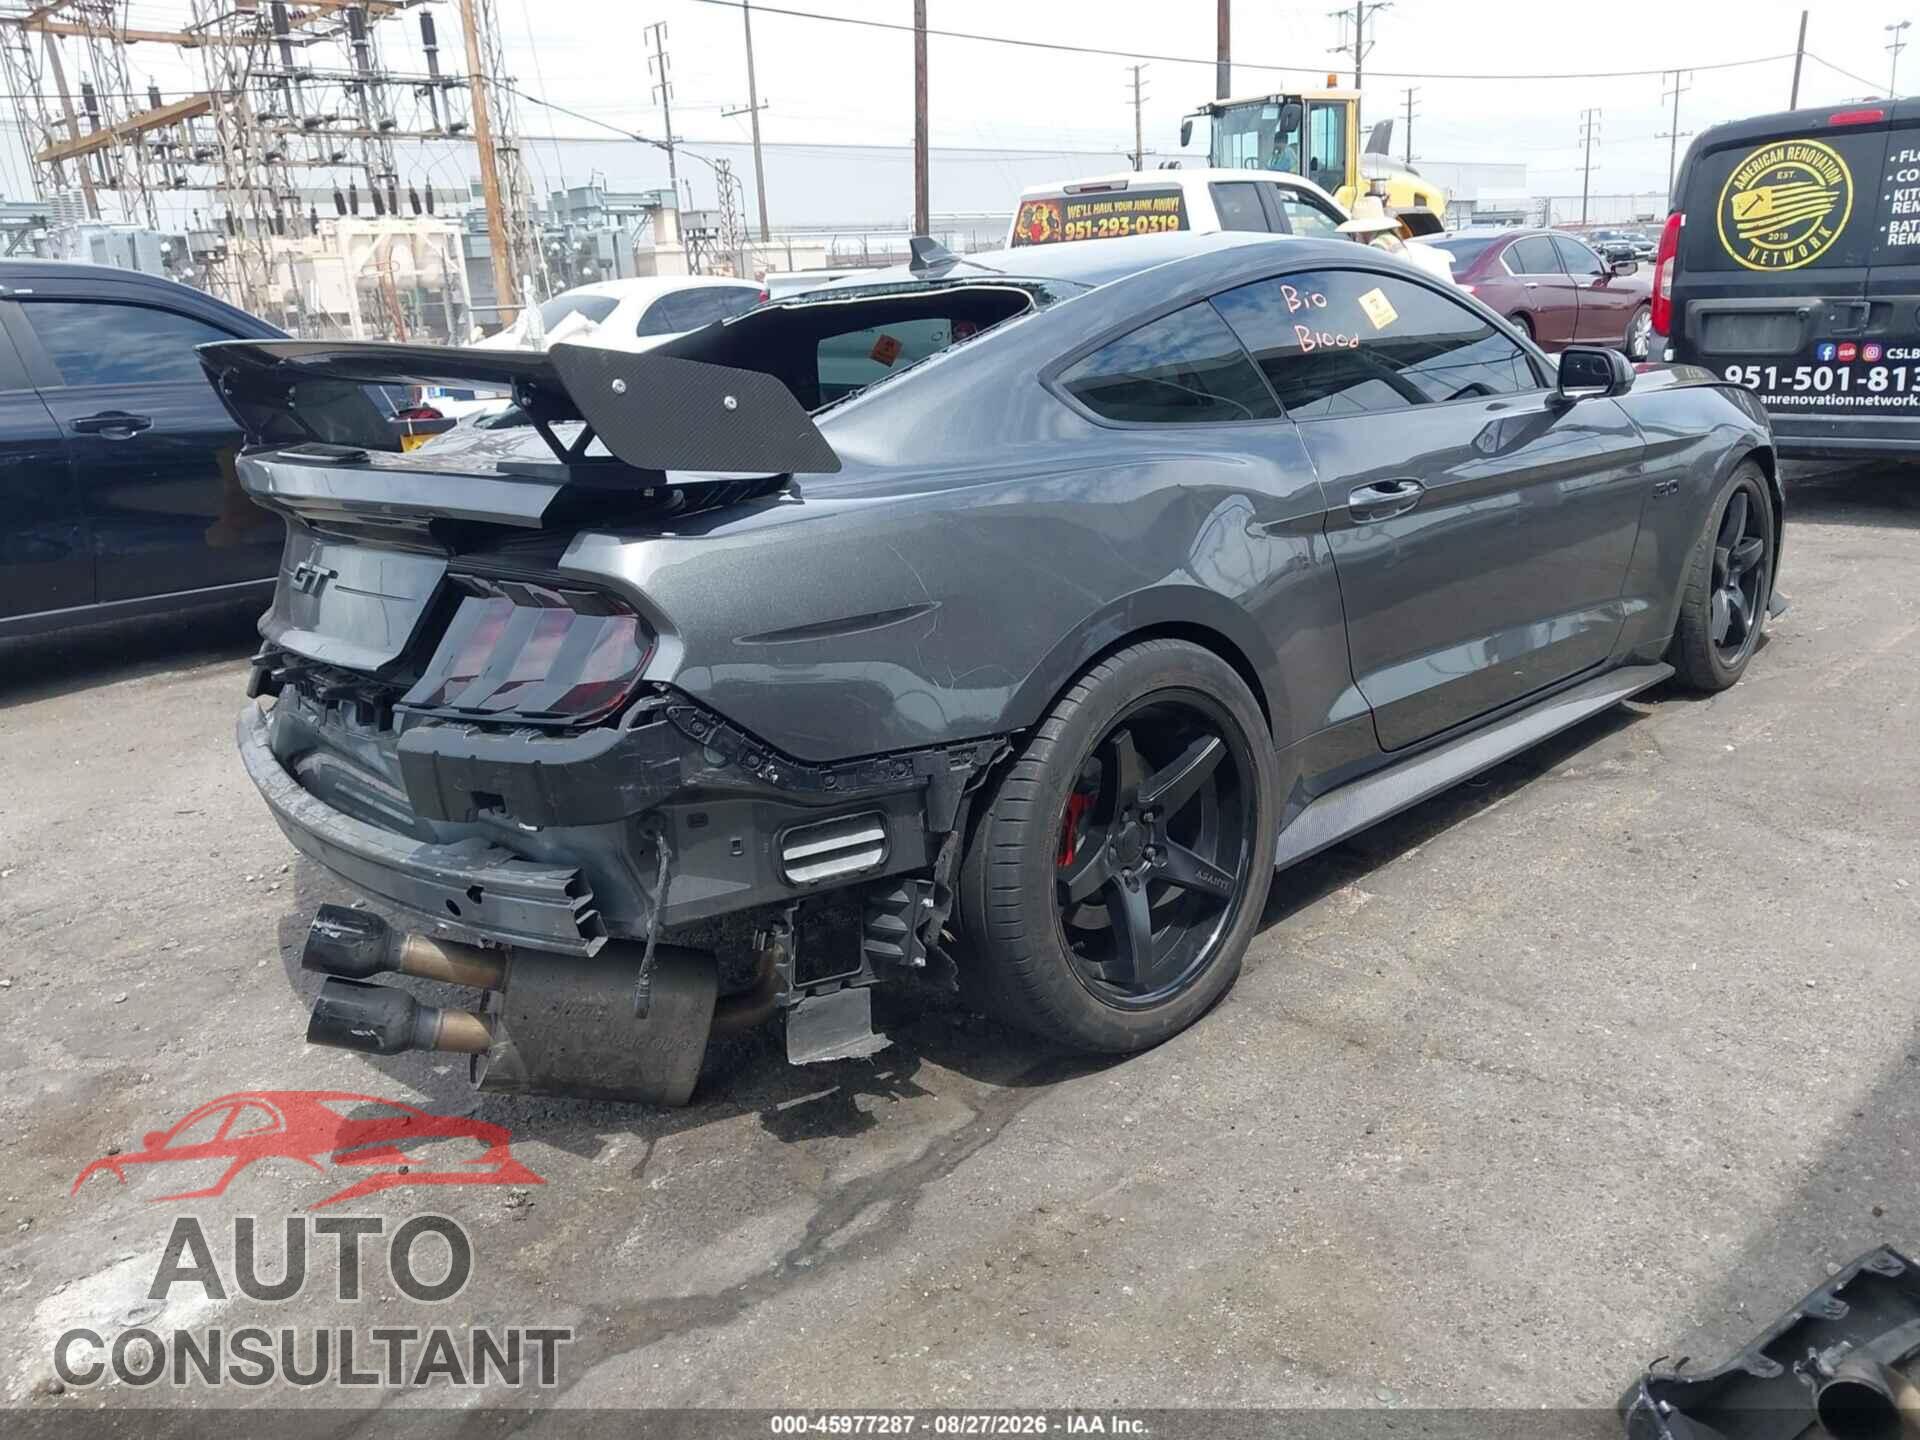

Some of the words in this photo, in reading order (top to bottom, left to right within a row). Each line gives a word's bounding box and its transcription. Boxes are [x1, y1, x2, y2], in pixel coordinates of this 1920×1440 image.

[1733, 146, 1785, 190] AMERICAN
[1786, 145, 1843, 186] RENOVATION
[1899, 149, 1920, 163] FL
[1893, 186, 1920, 202] KIT
[1067, 203, 1093, 219] WE'LL
[1093, 200, 1114, 214] HAUL
[1114, 200, 1134, 213] YOUR
[1134, 198, 1153, 212] JUNK
[1153, 196, 1180, 212] AWAY!
[1065, 214, 1179, 240] 951-293-0319
[1889, 219, 1920, 233] BAT
[1747, 225, 1833, 265] NETWORK
[1280, 285, 1328, 313] Bio
[1294, 324, 1359, 353] Blood
[1886, 347, 1920, 360] CSLB
[292, 560, 337, 595] GT
